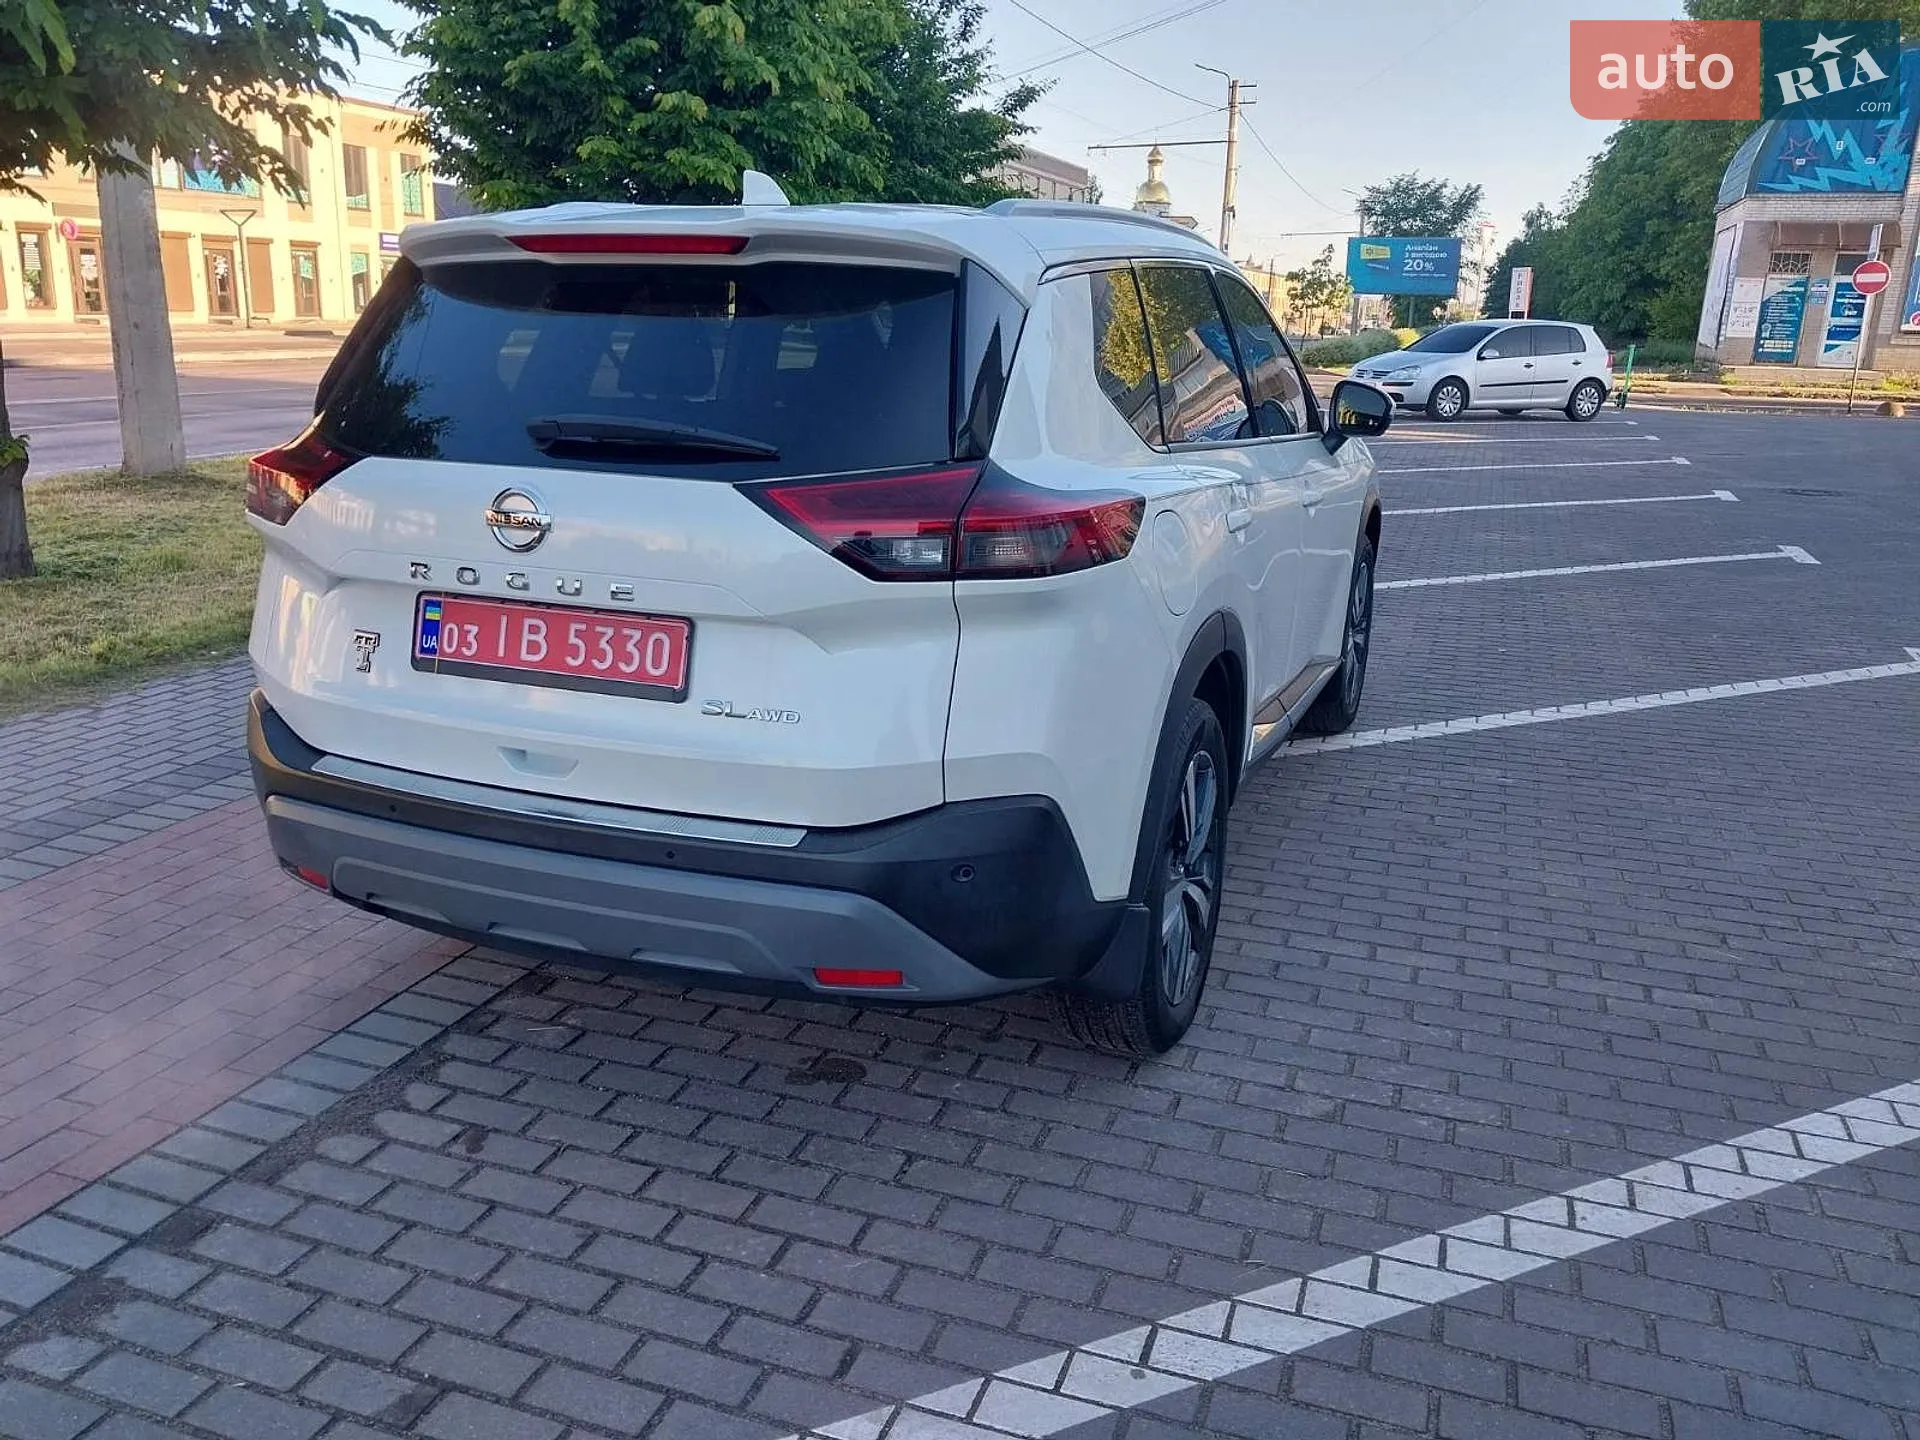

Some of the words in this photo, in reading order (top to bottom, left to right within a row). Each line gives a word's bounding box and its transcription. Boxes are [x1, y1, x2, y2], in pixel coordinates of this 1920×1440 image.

[1402, 259, 1435, 272] 20%
[487, 511, 542, 528] NISSAN
[409, 561, 635, 602] ROGUE
[422, 634, 438, 649] UA
[443, 622, 479, 657] 03
[496, 614, 549, 663] IB
[564, 622, 671, 677] 5330
[701, 699, 748, 716] SL
[747, 706, 801, 724] AWD
